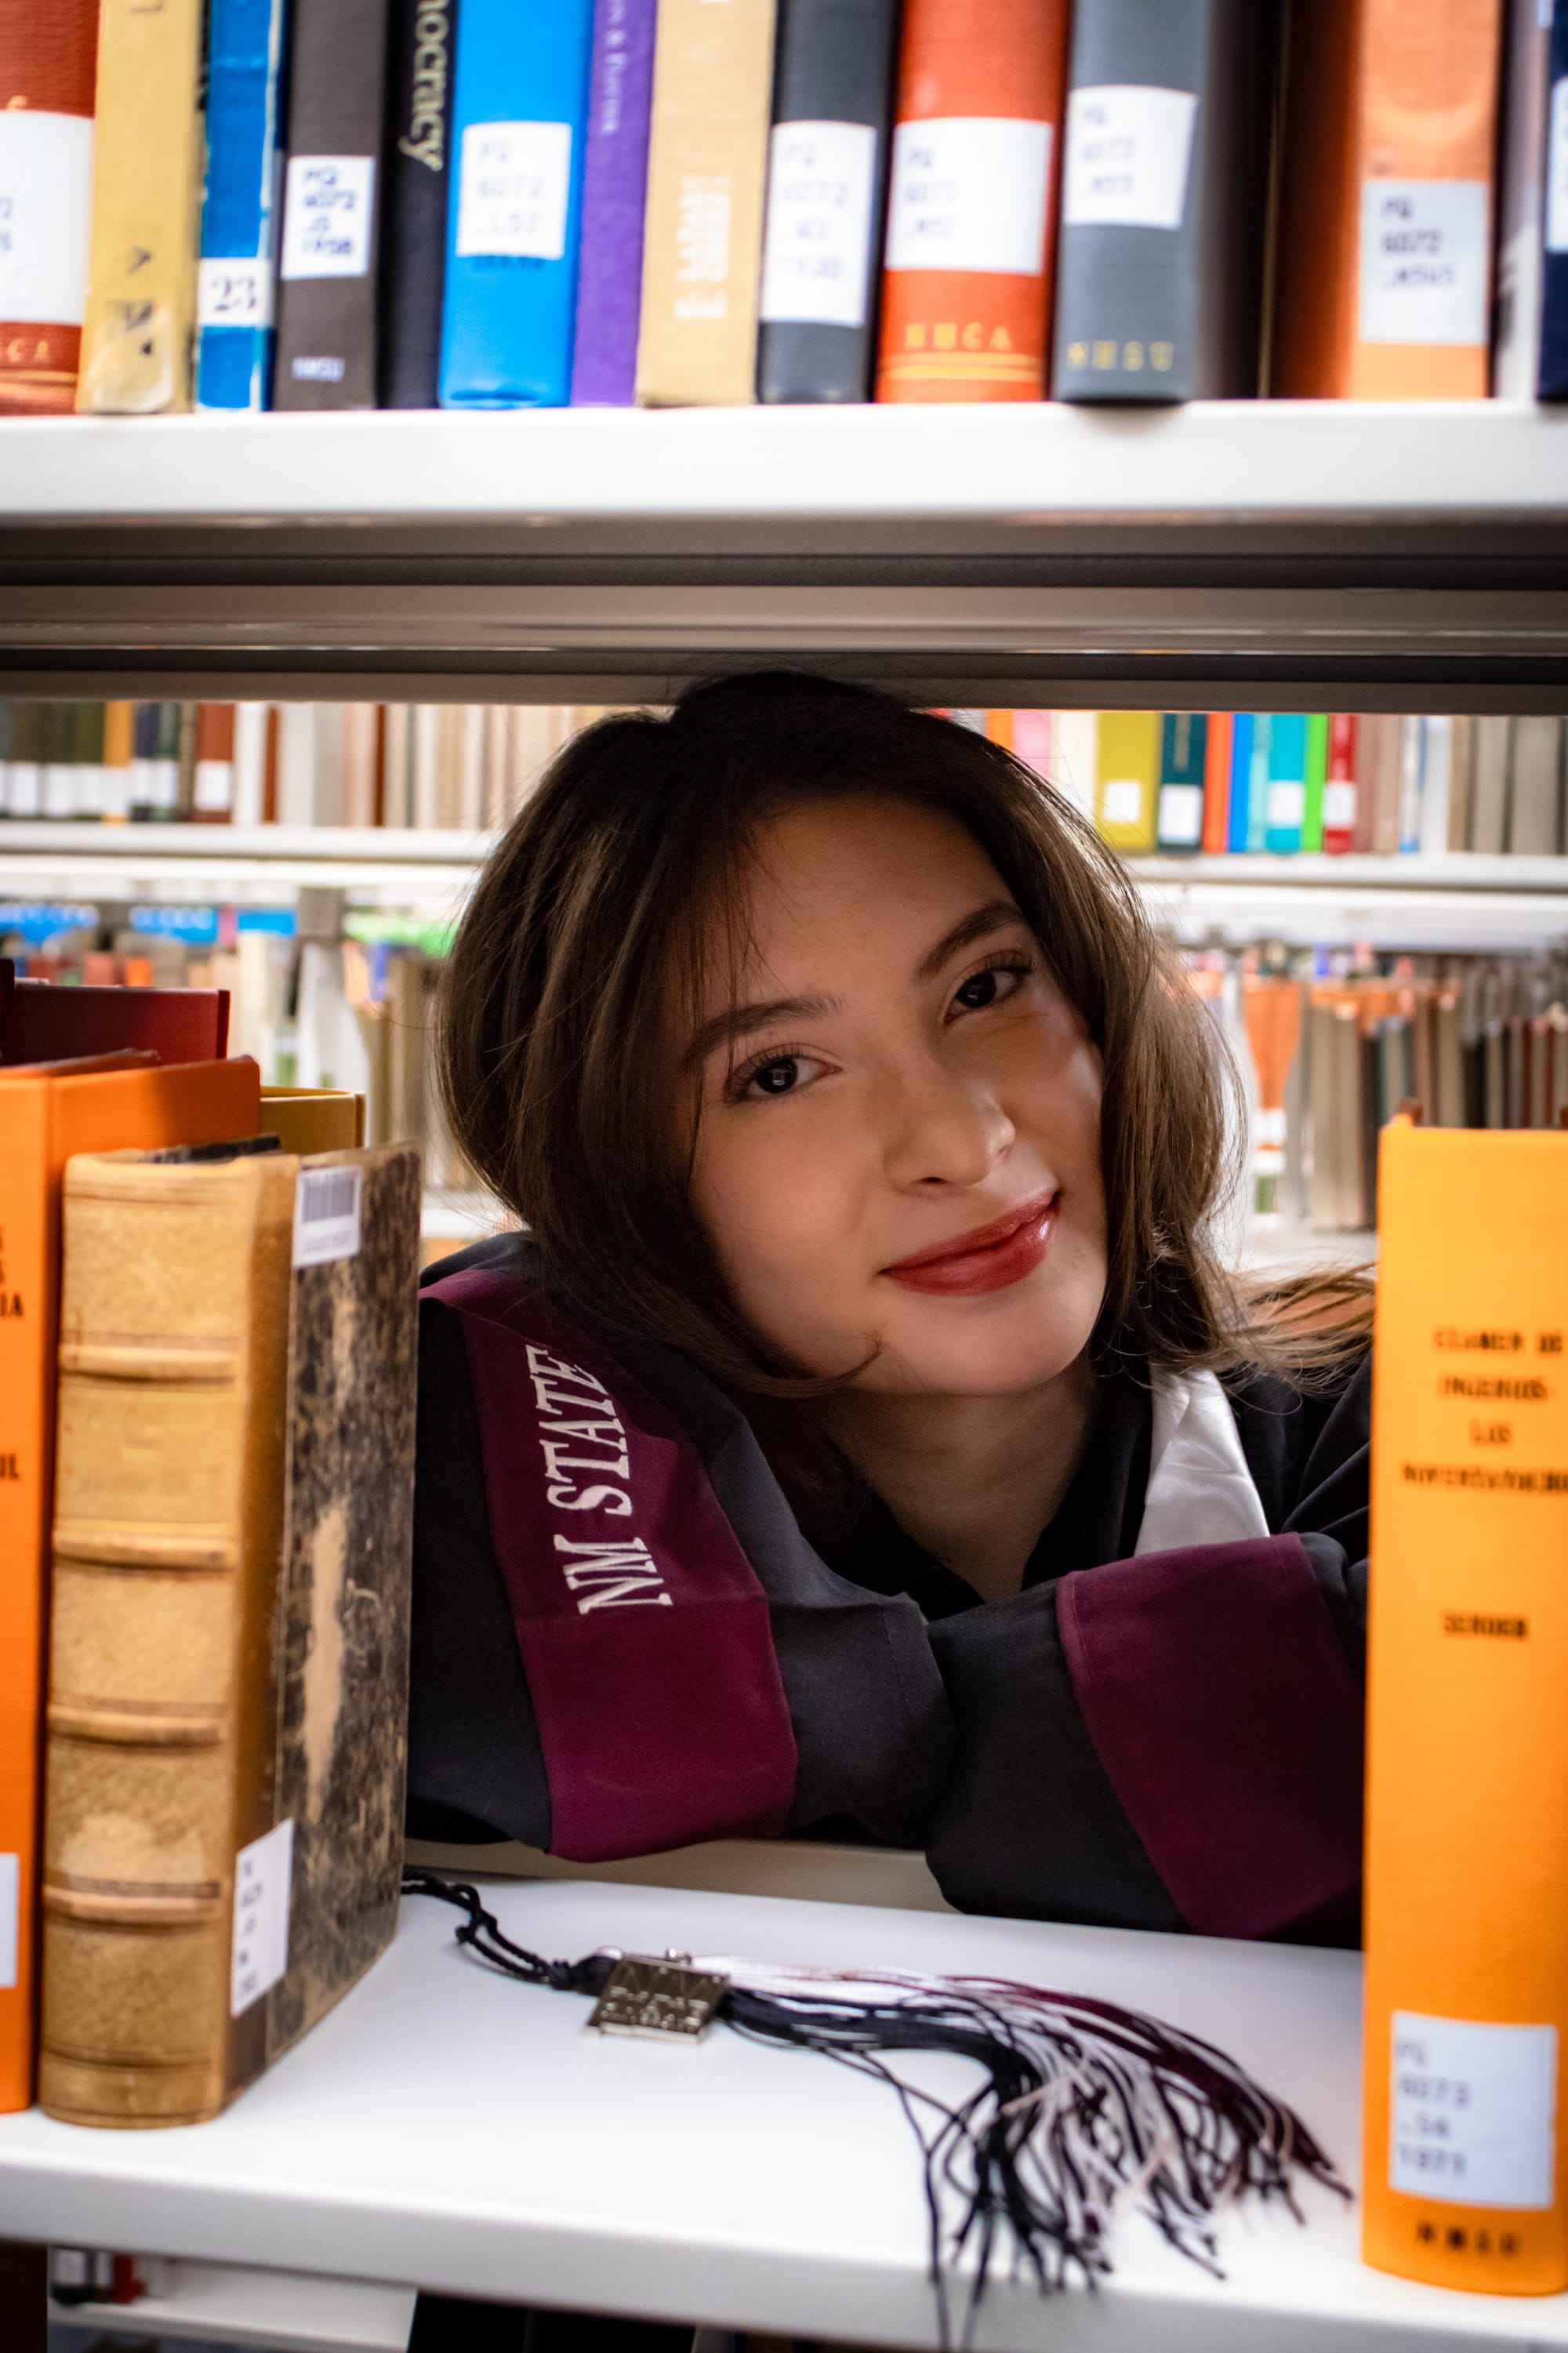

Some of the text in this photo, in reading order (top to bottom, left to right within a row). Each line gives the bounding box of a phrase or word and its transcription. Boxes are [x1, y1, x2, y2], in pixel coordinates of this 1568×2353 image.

[211, 275, 256, 311] 23
[525, 1344, 673, 1615] NM STATE
